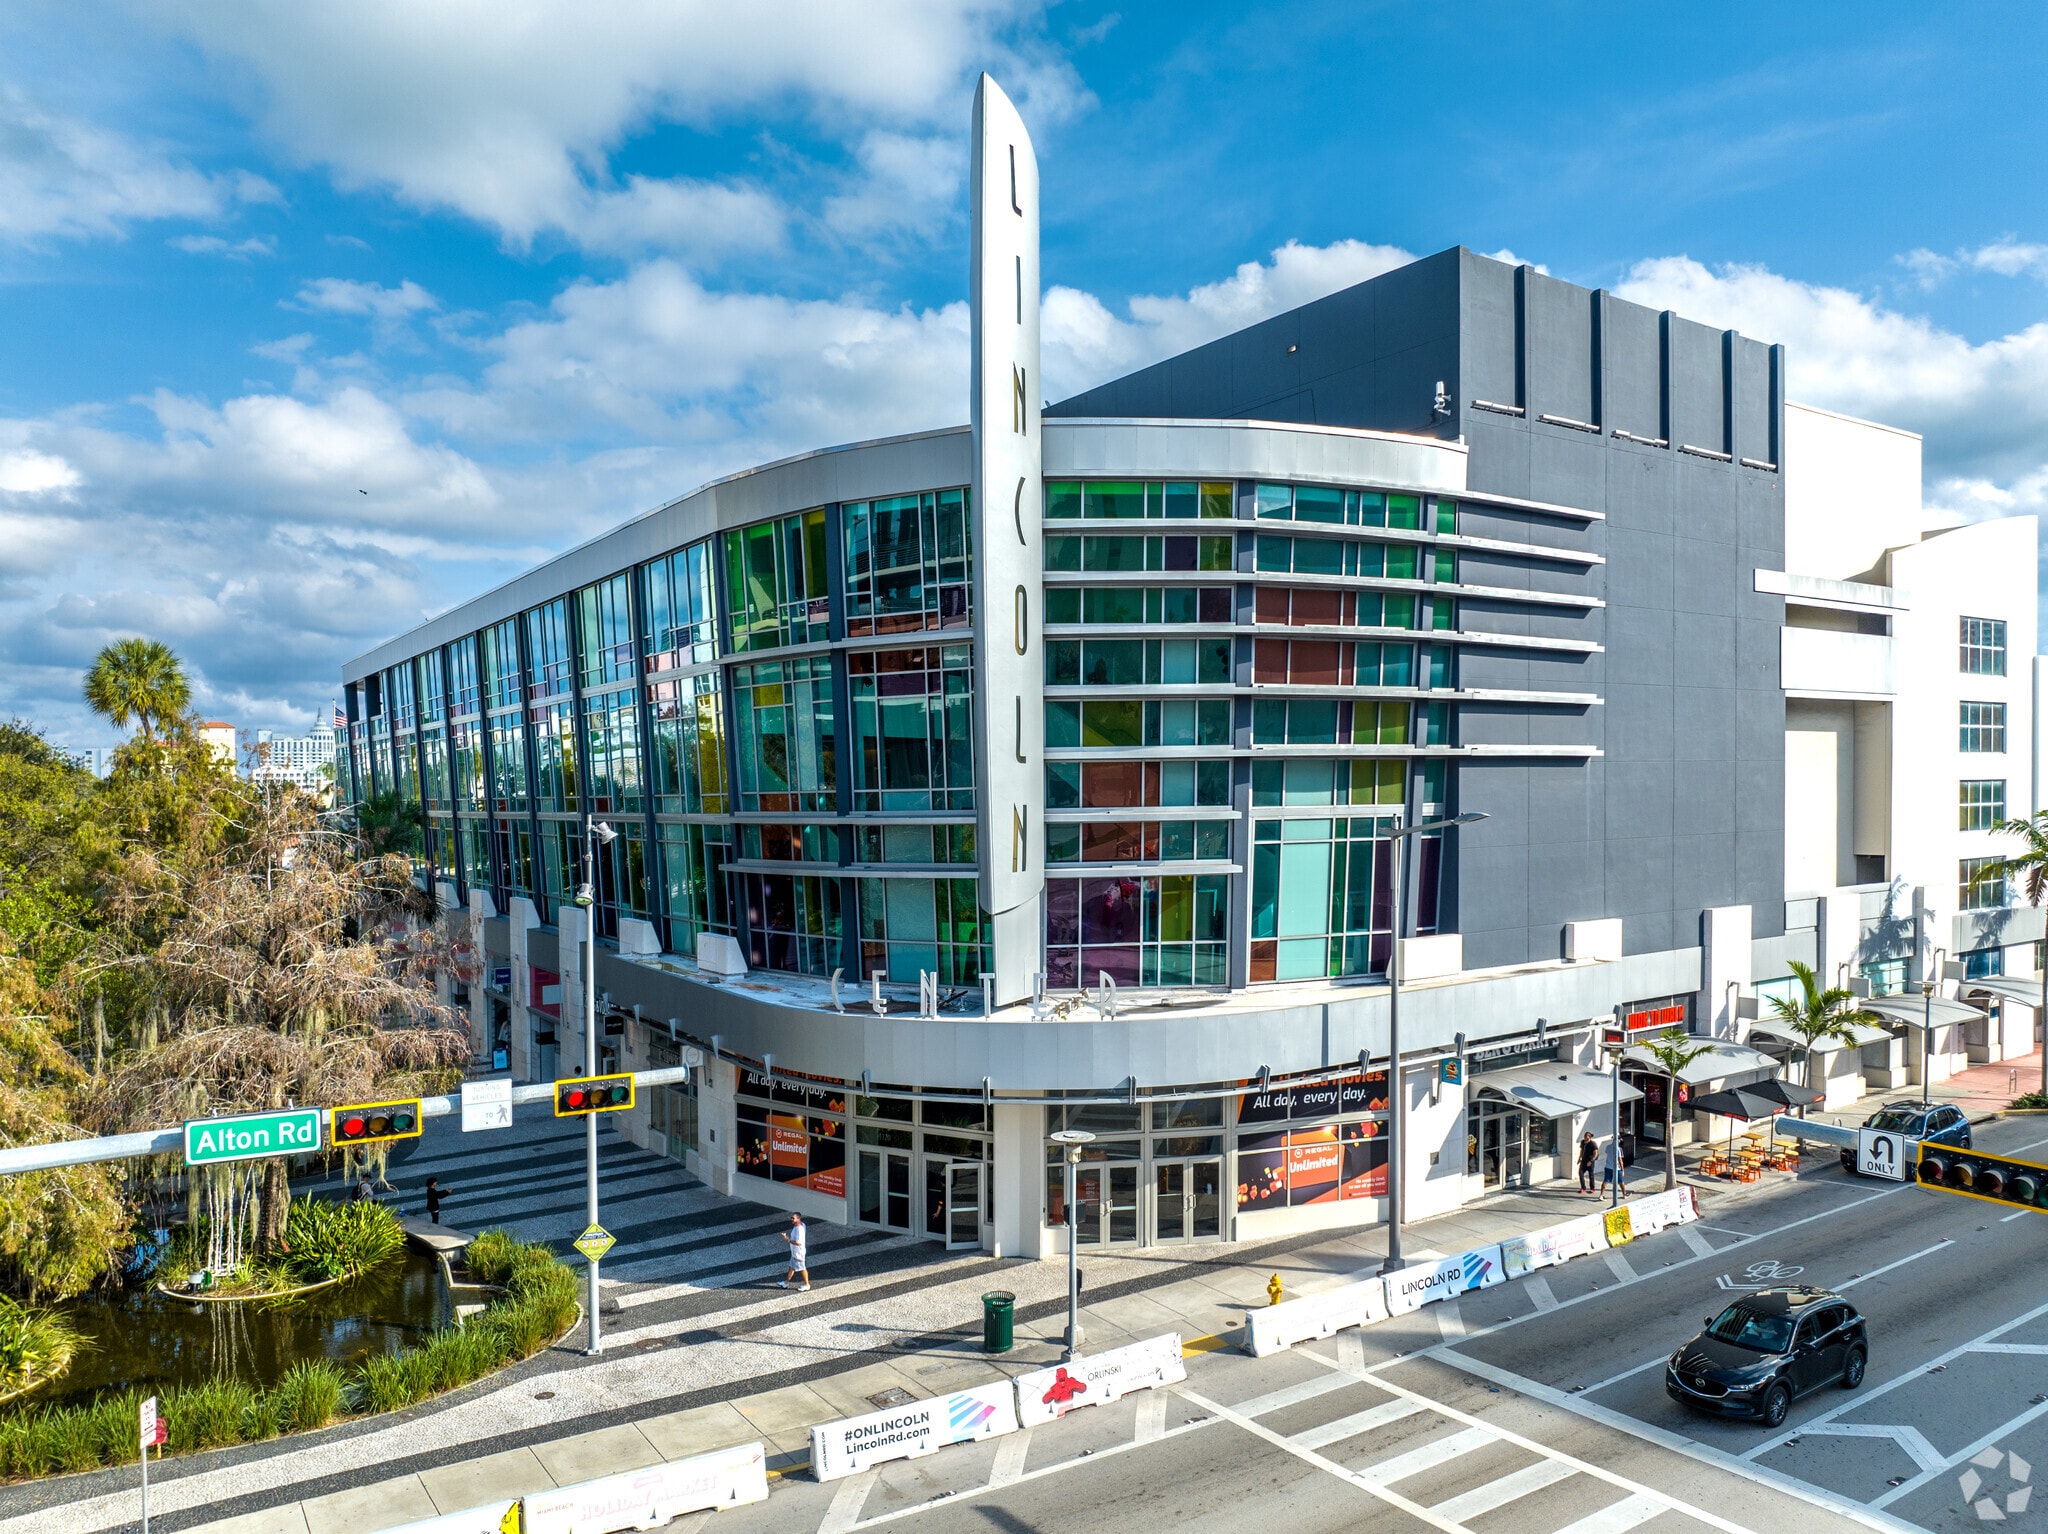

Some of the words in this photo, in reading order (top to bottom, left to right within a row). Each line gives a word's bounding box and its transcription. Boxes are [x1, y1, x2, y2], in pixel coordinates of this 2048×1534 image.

[1009, 144, 1028, 873] LINCOLN
[831, 967, 1117, 1020] CENTER
[1627, 1011, 1649, 1030] WOK
[1649, 1009, 1661, 1026] TO
[1661, 1005, 1685, 1025] WALK
[746, 1073, 759, 1084] All
[471, 1092, 503, 1101] VEHICLES
[472, 1083, 501, 1093] TURNING
[1253, 1095, 1271, 1109] All
[1274, 1094, 1297, 1107] day,
[1303, 1091, 1338, 1104] every
[1343, 1087, 1367, 1102] day.
[196, 1127, 270, 1155] Alton
[278, 1119, 312, 1146] Rd
[783, 1131, 804, 1139] REGAL
[772, 1140, 807, 1154] Unlimited
[1304, 1145, 1333, 1155] REGAL
[1290, 1154, 1338, 1173] Unlimited
[1866, 1160, 1896, 1175] ONLY
[1401, 1271, 1446, 1295] LINCOLN
[1448, 1268, 1461, 1281] RD
[1087, 1364, 1122, 1382] ORLINSKI
[844, 1411, 930, 1442] #ONLINCOLN
[846, 1426, 930, 1455] LincolnRd.com
[536, 1506, 554, 1515] MIAMI
[555, 1502, 574, 1511] BEACH
